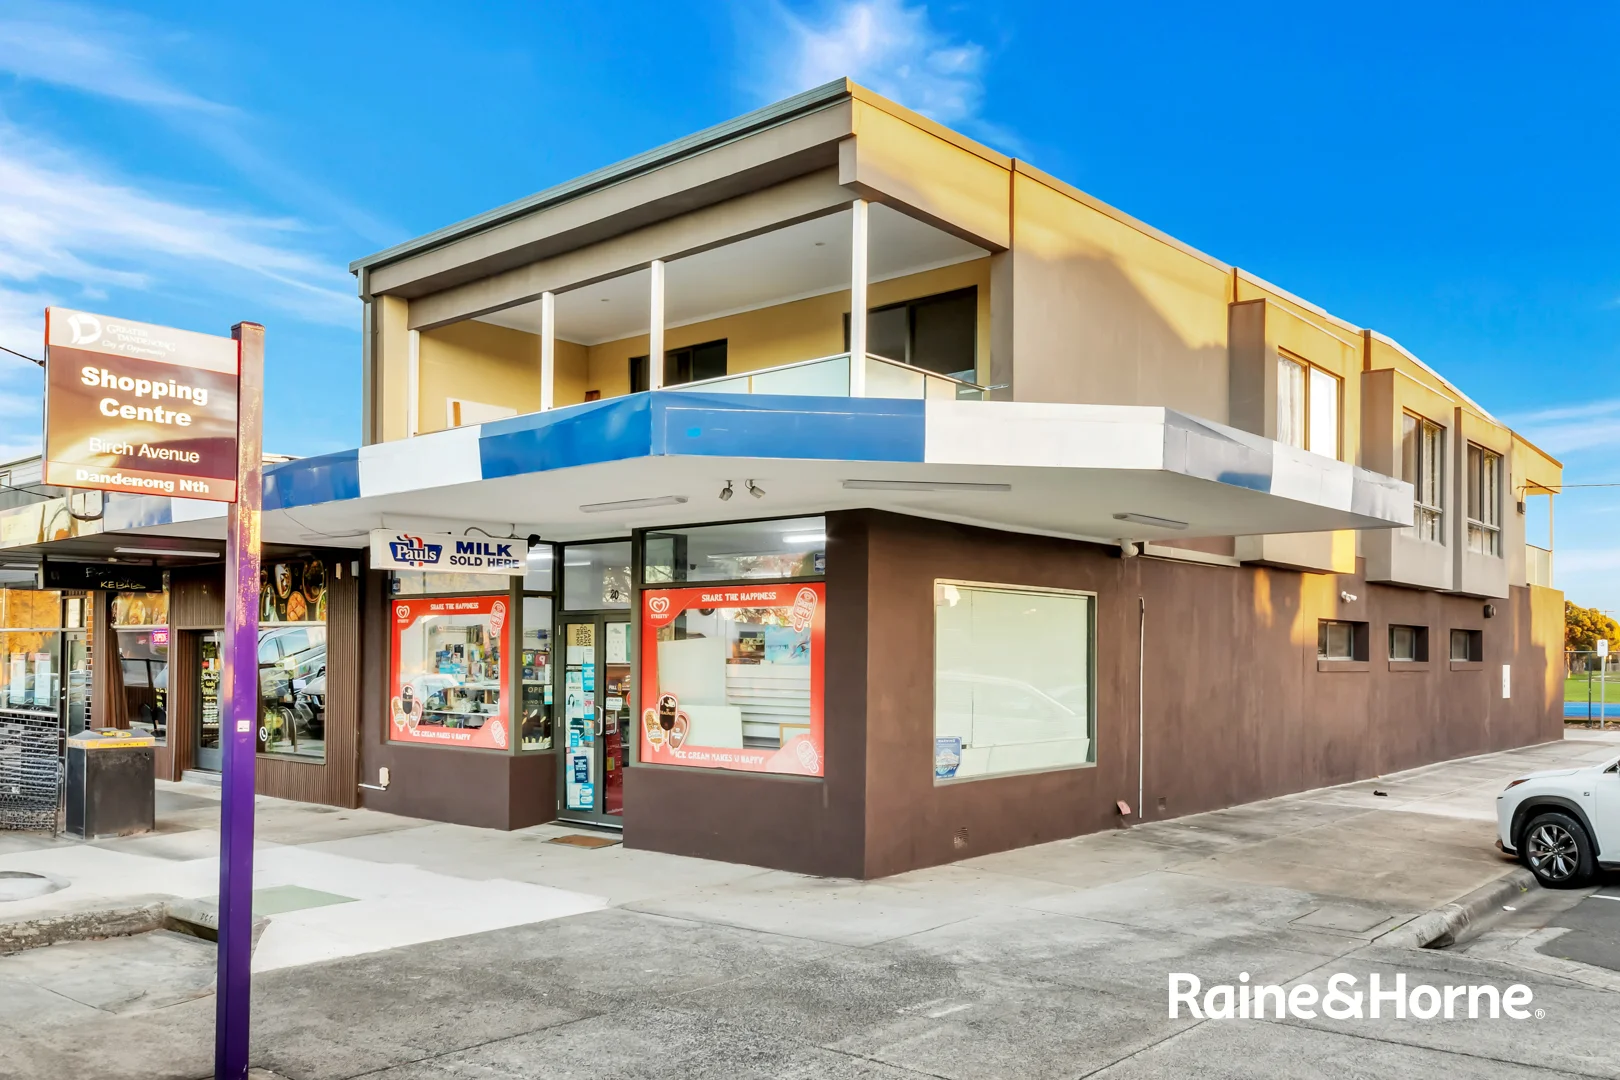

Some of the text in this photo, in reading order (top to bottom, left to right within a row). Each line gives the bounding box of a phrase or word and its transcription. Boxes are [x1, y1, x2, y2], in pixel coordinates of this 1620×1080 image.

[81, 366, 209, 406] Shopping
[99, 398, 192, 426] Centre
[89, 437, 201, 463] Birch Avenue
[76, 469, 210, 493] Dandenong Nth
[395, 544, 437, 561] Pauls
[456, 541, 513, 557] MILK
[450, 555, 520, 569] SOLD HERE
[610, 588, 620, 600] 20
[701, 591, 777, 602] SHARE THE HAPPINESS
[675, 751, 687, 759] ICE
[687, 751, 711, 760] CREAM
